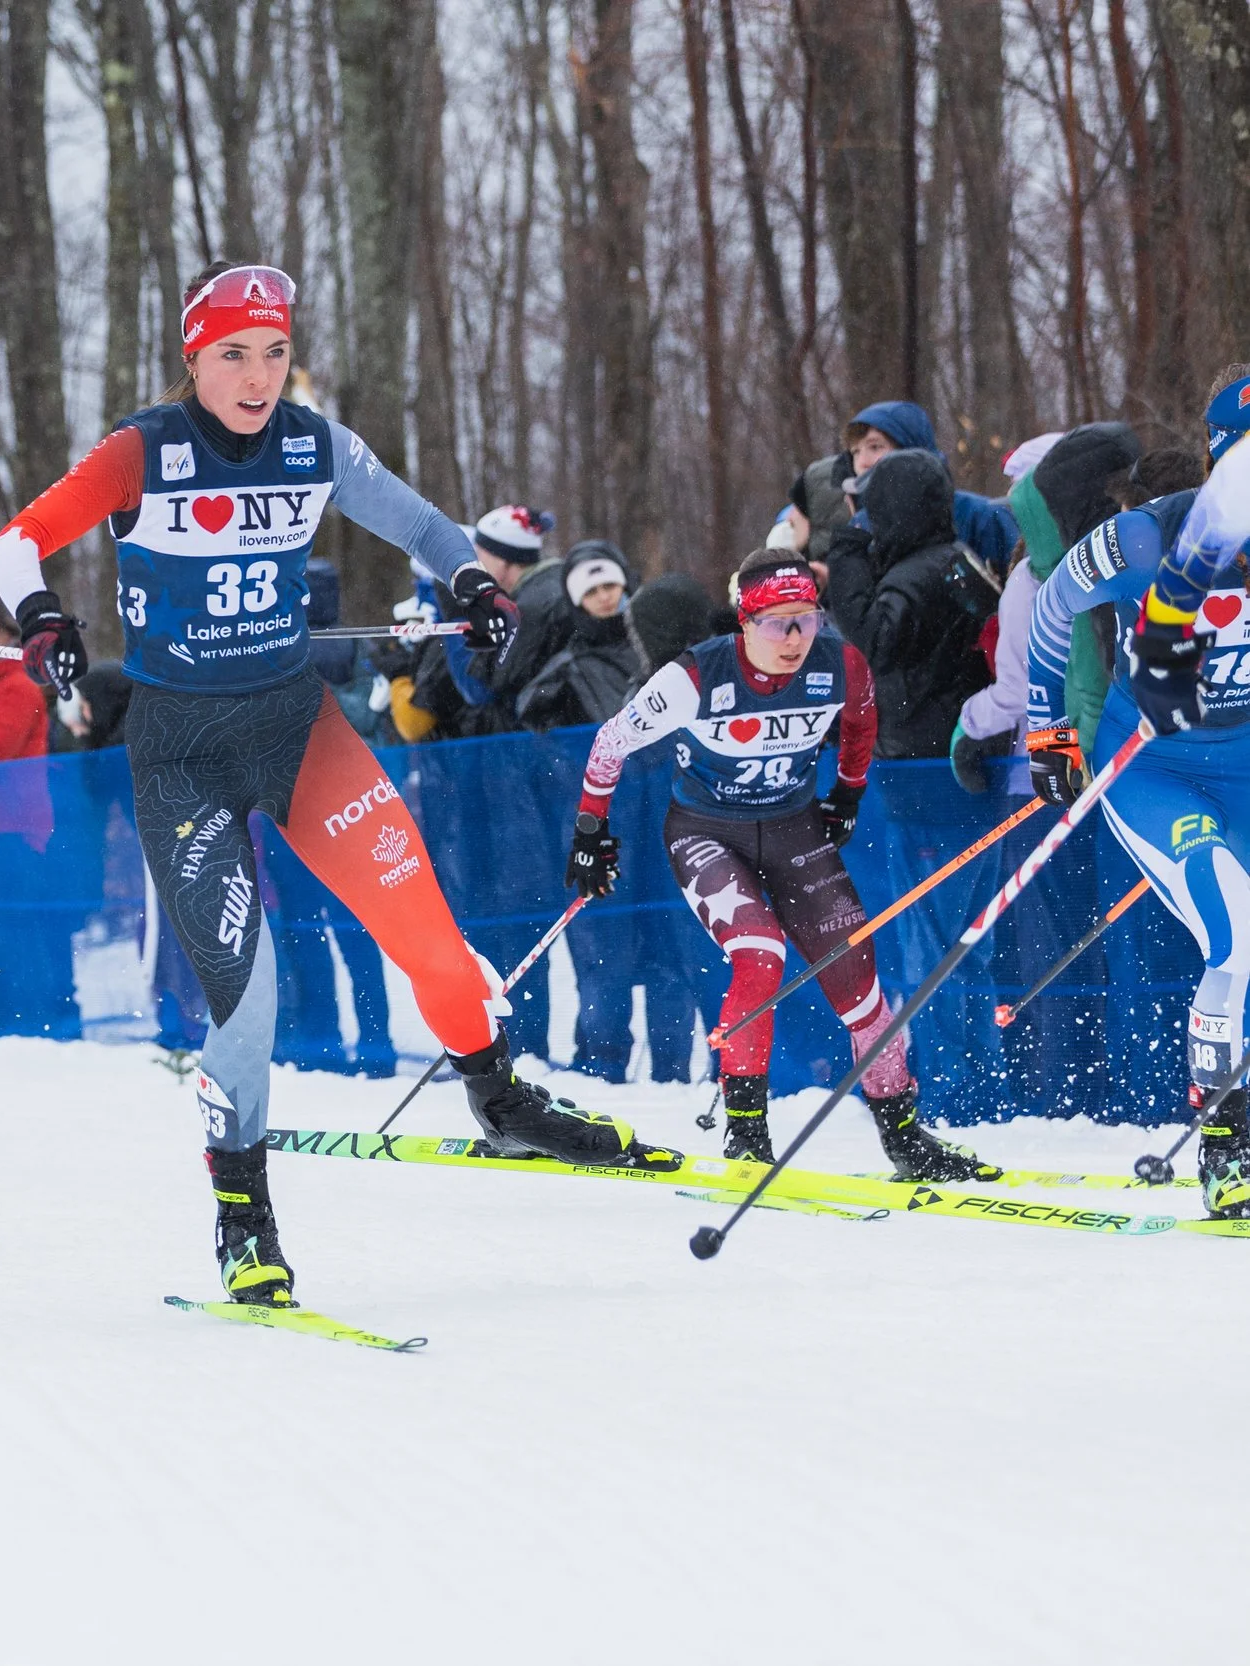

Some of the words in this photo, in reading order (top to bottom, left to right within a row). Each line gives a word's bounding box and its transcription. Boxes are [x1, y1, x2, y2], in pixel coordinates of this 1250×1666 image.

[248, 309, 284, 321] nordiq
[285, 456, 315, 467] coop
[167, 497, 188, 532] I
[239, 529, 308, 547] iloveny.com
[206, 560, 278, 616] 33
[187, 623, 232, 641] Lake
[237, 614, 292, 636] Placid
[200, 650, 217, 659] MT
[219, 646, 242, 658] VAN
[709, 721, 726, 741] I
[181, 808, 233, 880] HAYWOOD
[380, 855, 420, 887] nordiq
[388, 868, 420, 889] CANADA
[1193, 1043, 1217, 1071] 18
[573, 1166, 656, 1179] FISCHER
[954, 1198, 1132, 1230] FISCHER
[248, 1307, 270, 1320] FISCHER
